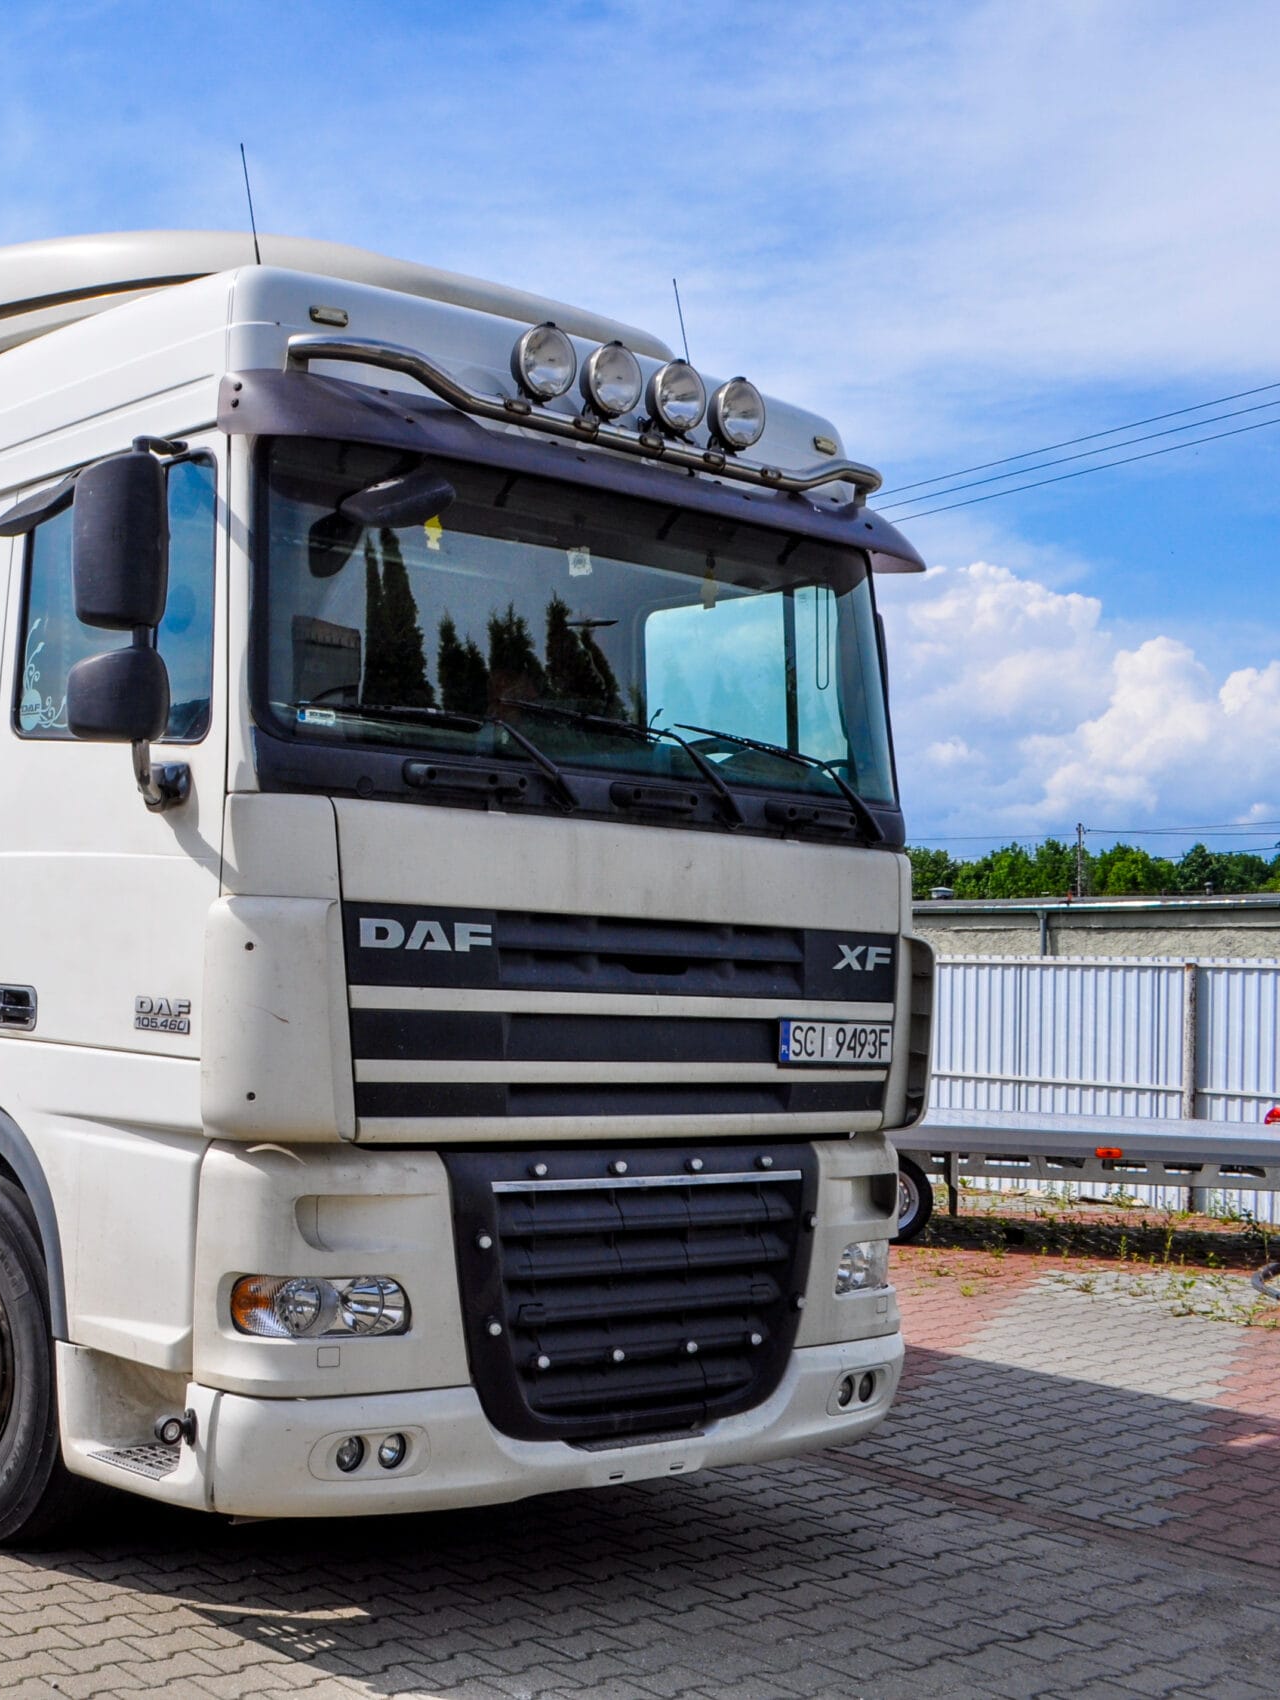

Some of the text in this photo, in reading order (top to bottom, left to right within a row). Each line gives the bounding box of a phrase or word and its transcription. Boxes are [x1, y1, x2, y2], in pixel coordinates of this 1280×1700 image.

[359, 917, 492, 952] DAF
[832, 944, 892, 971] XF
[135, 995, 191, 1017] DAF
[792, 1025, 890, 1060] SCI 9493F
